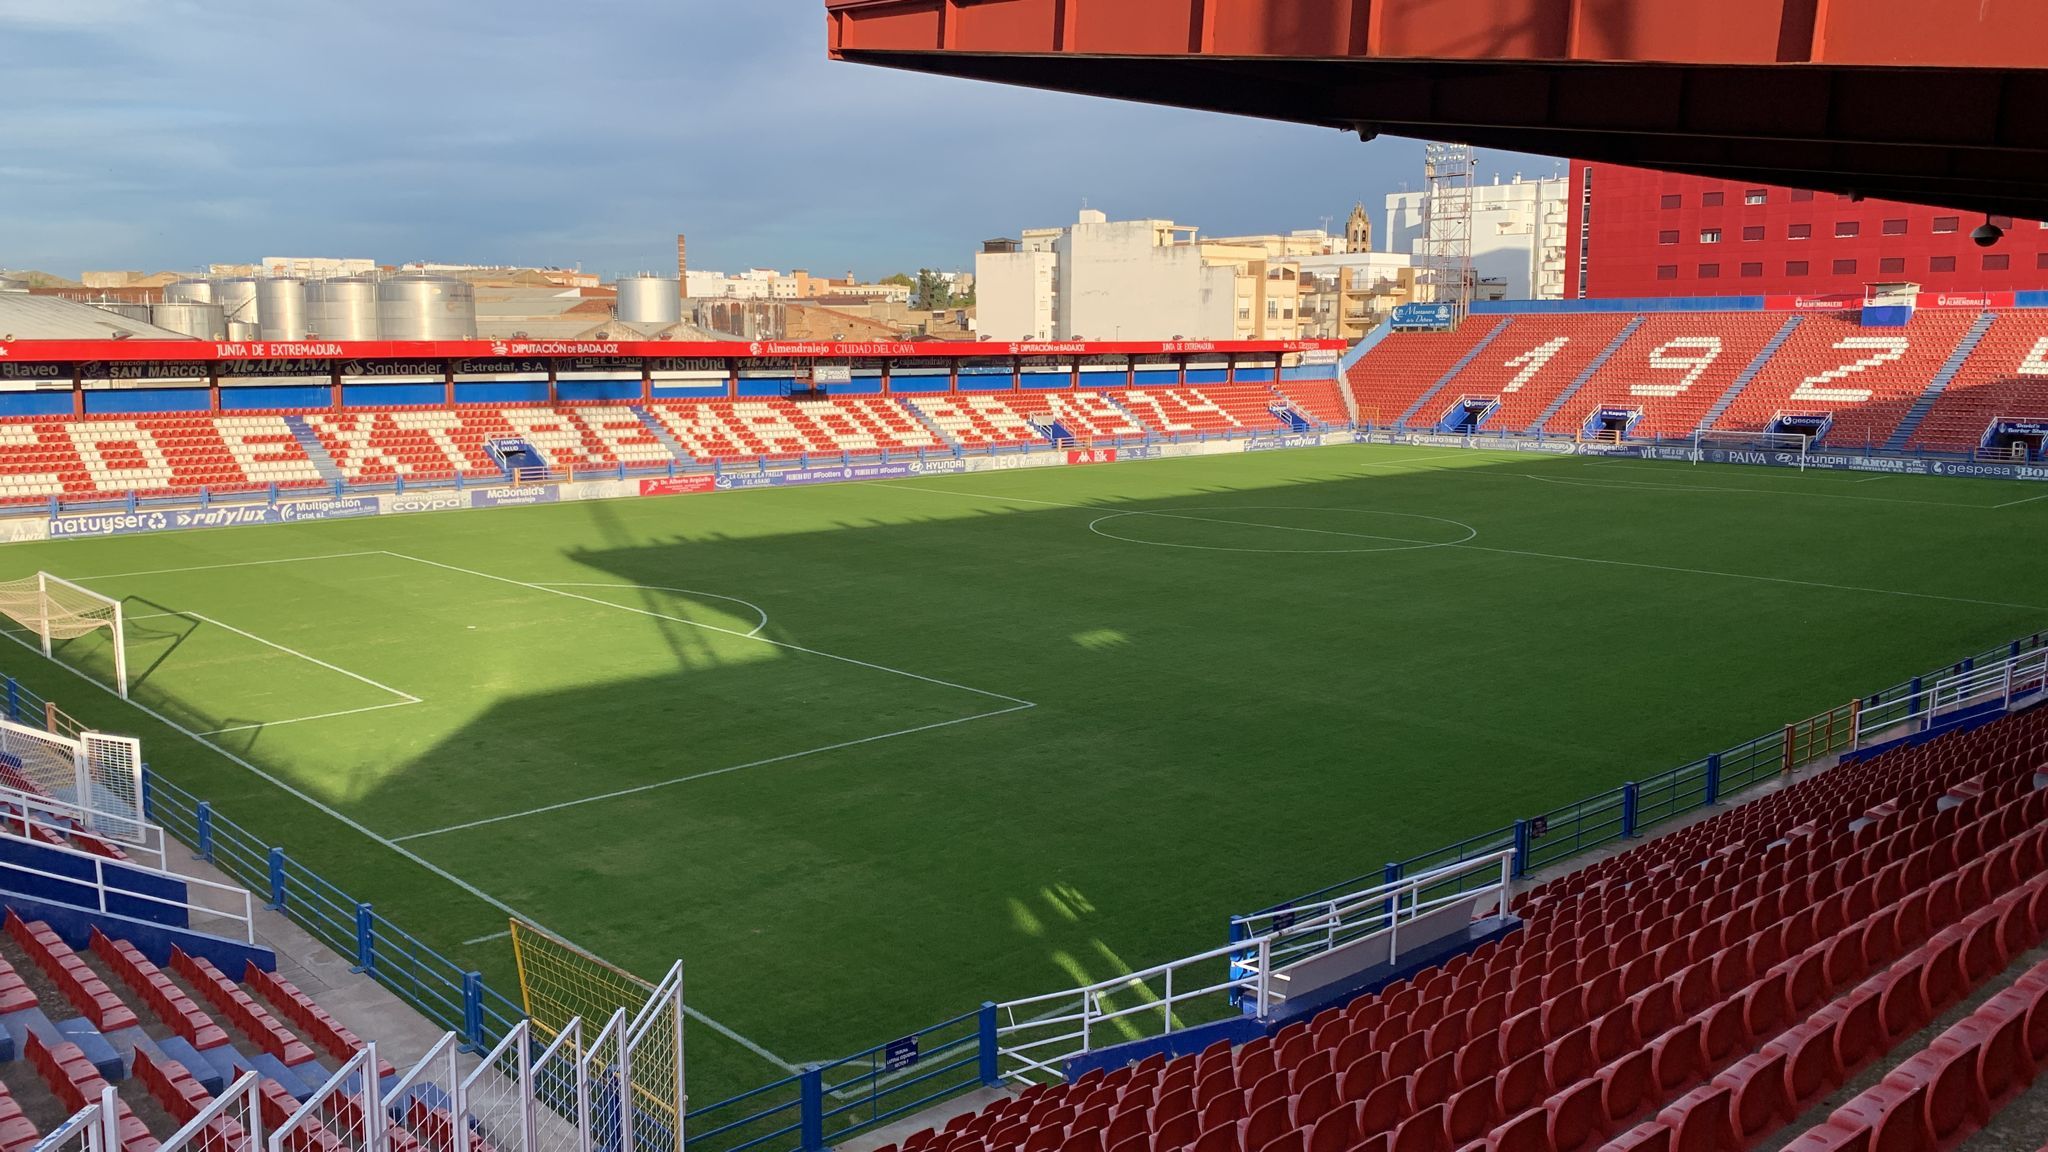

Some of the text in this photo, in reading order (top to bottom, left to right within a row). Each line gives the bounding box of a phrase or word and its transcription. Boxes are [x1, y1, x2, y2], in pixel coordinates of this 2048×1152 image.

[216, 344, 343, 358] JUNTA DE EXTREMADURA
[512, 341, 566, 354] DIPUTACIÓN
[577, 343, 618, 354] BADAJOZ
[767, 343, 915, 354] Almendralejo CIUDAD DEL CAVA
[1020, 343, 1053, 352] DIPUTACIÓN
[1060, 343, 1085, 352] BADAJOZ
[1162, 343, 1215, 351] JUNTA DE EXTREMADURA
[110, 366, 209, 378] SAN MARCOS
[366, 360, 442, 375] Santander
[522, 361, 548, 372] S.A.
[1587, 442, 1628, 451] Multigestión
[992, 457, 1017, 469] LEO
[1729, 451, 1766, 464] PAIVA
[1797, 456, 1847, 465] HYUNDAI
[926, 460, 965, 470] HYUNDAI
[1947, 464, 2010, 476] gespesa
[669, 477, 688, 485] Alberto
[487, 486, 545, 499] McDonald's
[296, 499, 361, 513] Multigestión
[393, 499, 460, 512] caypa
[51, 514, 147, 534] natuyser
